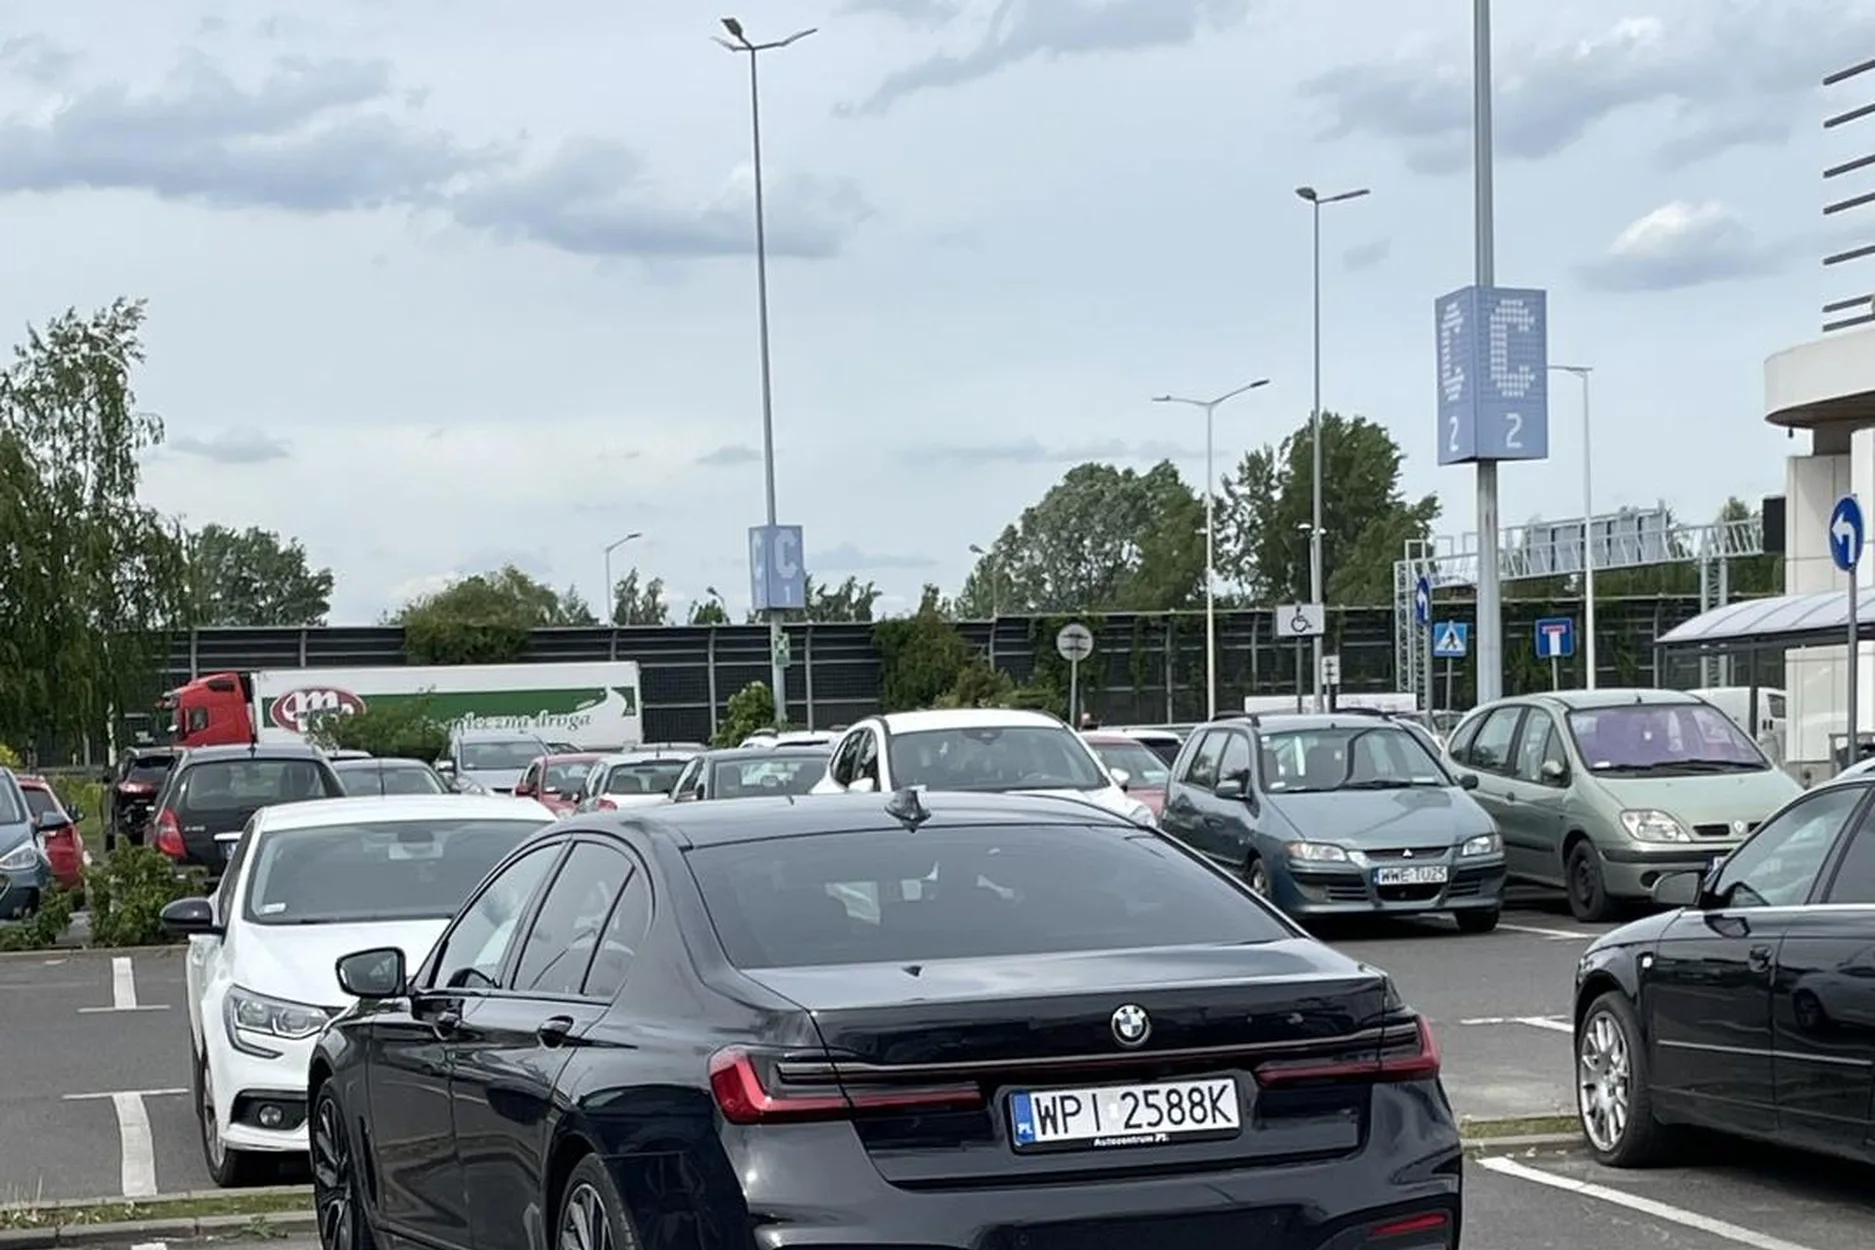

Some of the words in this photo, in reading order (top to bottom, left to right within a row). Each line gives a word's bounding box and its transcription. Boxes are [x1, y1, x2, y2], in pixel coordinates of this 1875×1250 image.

[1441, 301, 1464, 401] C
[1490, 299, 1535, 397] C
[1449, 415, 1459, 452] 2
[1505, 412, 1523, 448] 2
[774, 528, 798, 579] C
[784, 585, 791, 603] 1
[535, 710, 592, 731] droga
[1034, 1093, 1100, 1136] WPI
[1120, 1084, 1232, 1130] 2588K
